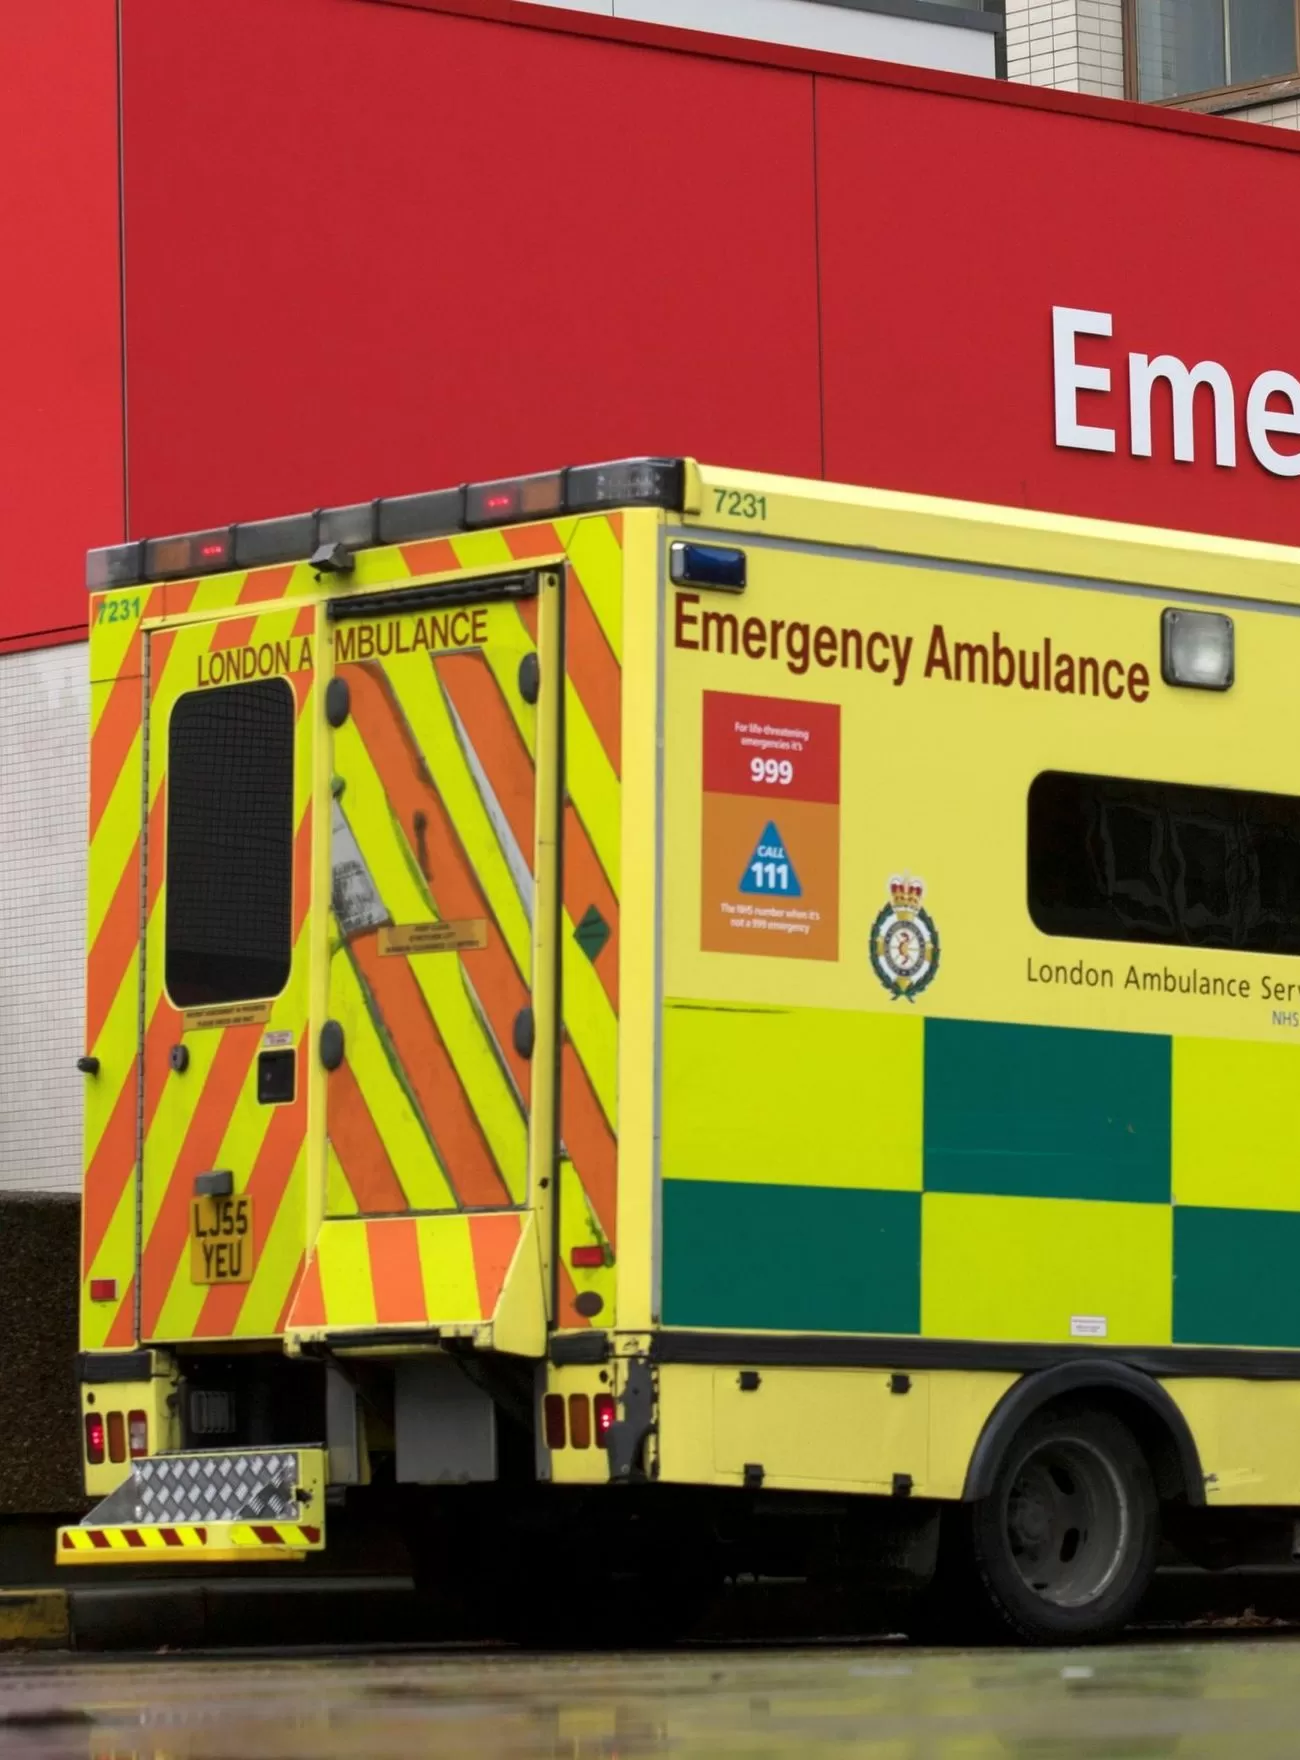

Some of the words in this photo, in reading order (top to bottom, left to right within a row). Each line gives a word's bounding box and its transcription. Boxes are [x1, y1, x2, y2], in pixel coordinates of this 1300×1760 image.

[713, 489, 768, 520] 7231
[96, 596, 141, 625] 7231
[198, 639, 291, 687] LONDON
[674, 592, 913, 686] Emergency
[924, 624, 1150, 704] Ambulance
[750, 756, 794, 786] 999
[756, 845, 785, 859] CALL
[751, 861, 789, 890] 111
[1027, 957, 1114, 988] London
[1124, 964, 1250, 999] Ambulance
[1271, 1010, 1300, 1028] NHS
[194, 1200, 248, 1238] LJ55
[202, 1240, 243, 1278] YEU
